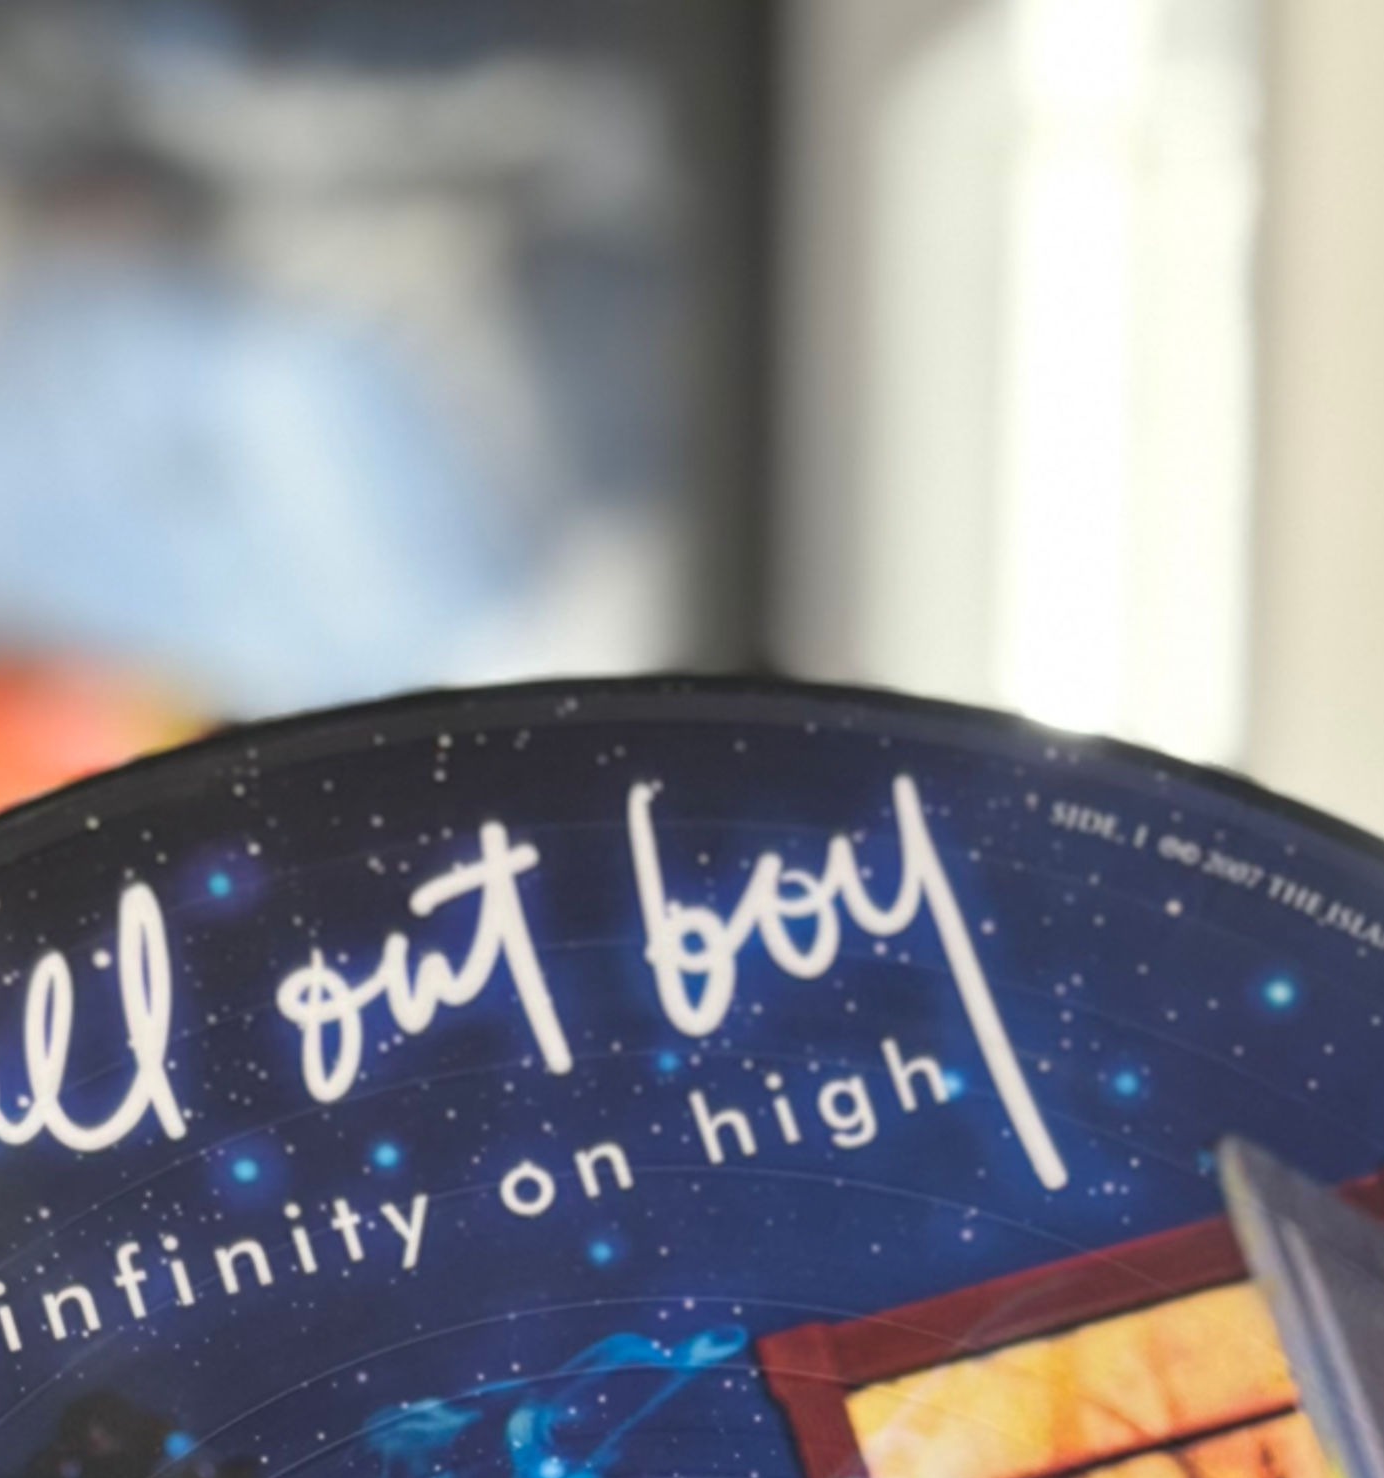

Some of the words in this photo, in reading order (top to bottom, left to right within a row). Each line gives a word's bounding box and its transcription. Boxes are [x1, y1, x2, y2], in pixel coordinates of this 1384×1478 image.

[278, 822, 574, 1103] out
[626, 776, 1069, 1191] boy
[1267, 874, 1326, 918] THE
[499, 1137, 634, 1217] on
[688, 1038, 953, 1168] high
